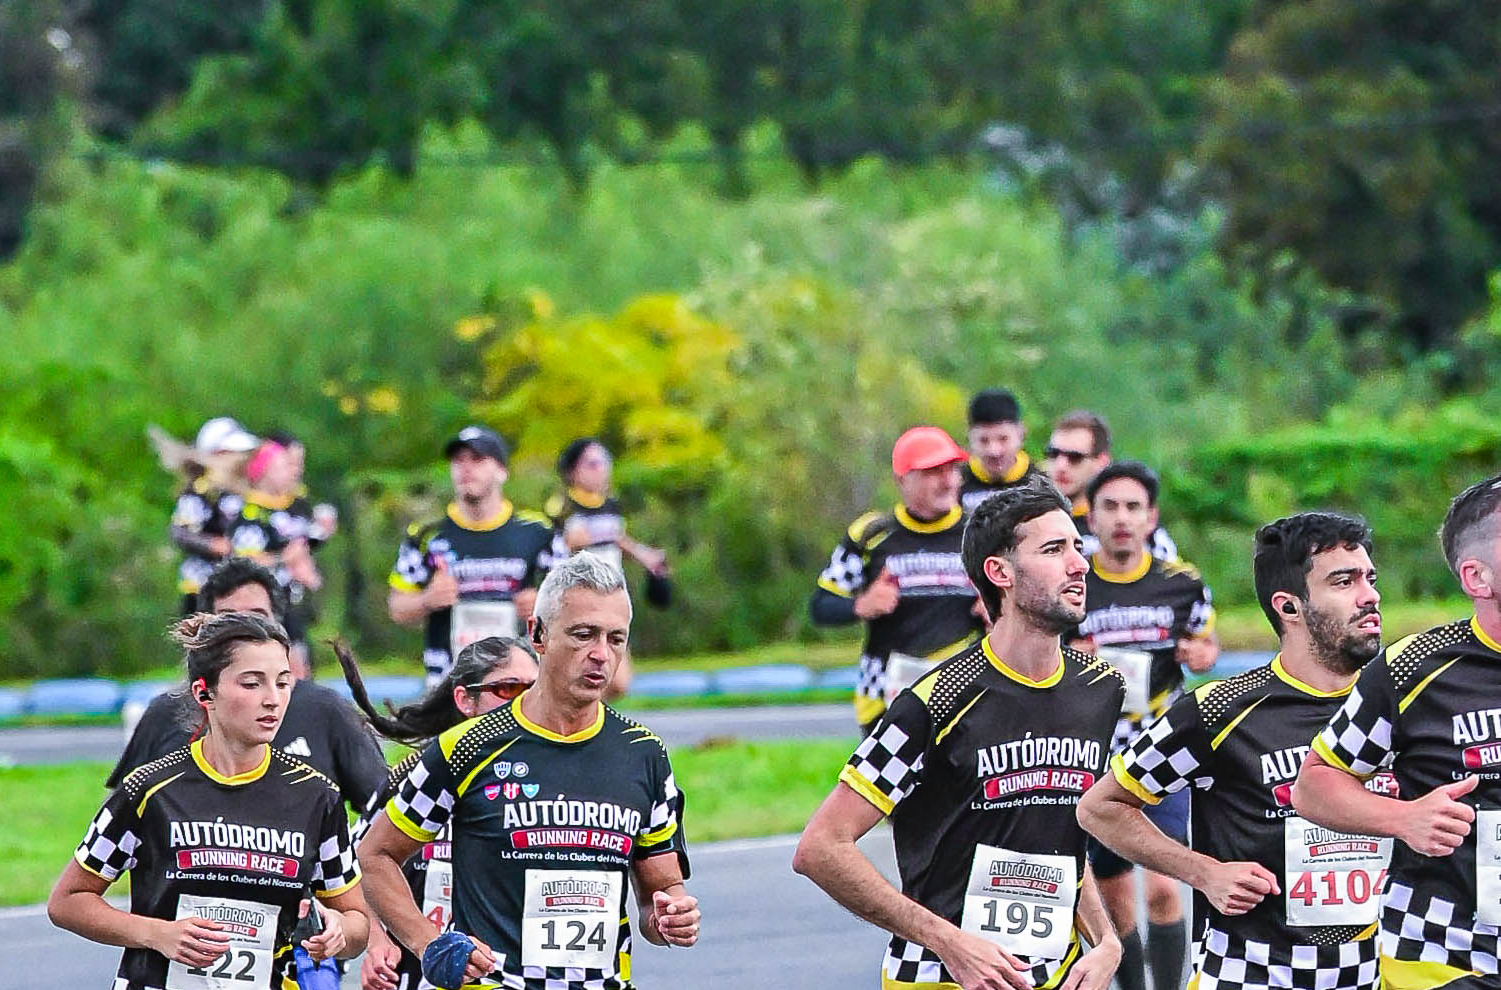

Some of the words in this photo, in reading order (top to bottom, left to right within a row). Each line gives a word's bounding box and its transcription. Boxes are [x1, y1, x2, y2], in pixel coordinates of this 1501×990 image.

[977, 731, 1100, 777] AUTÓDROMO
[1051, 771, 1085, 790] RACE
[1365, 776, 1391, 793] ACE
[1465, 771, 1500, 780] Crrera
[971, 801, 982, 810] La
[983, 800, 1012, 811] Carrera
[1058, 795, 1072, 805] del
[1265, 809, 1276, 818] La
[503, 793, 641, 836] AUTÓDROMO
[169, 816, 305, 858] AUTÓDROMO
[527, 830, 588, 847] RUNNING
[590, 832, 625, 852] RACE
[1351, 842, 1371, 852] RACE
[190, 850, 248, 868] RUNNING
[250, 854, 286, 874] RACE
[501, 851, 511, 859] La
[512, 851, 543, 860] Carrera
[544, 852, 555, 860] de
[556, 852, 568, 861] los
[570, 852, 596, 862] Clubes
[597, 854, 609, 863] del
[166, 870, 174, 879] La
[176, 871, 205, 880] Carrera
[206, 872, 217, 881] de
[218, 872, 229, 882] los
[231, 874, 257, 884] Clubes
[258, 877, 271, 886] del
[989, 858, 1064, 883] AUTÓDROMO
[980, 900, 1053, 938] 195
[541, 920, 606, 951] 124
[187, 950, 256, 982] 22
